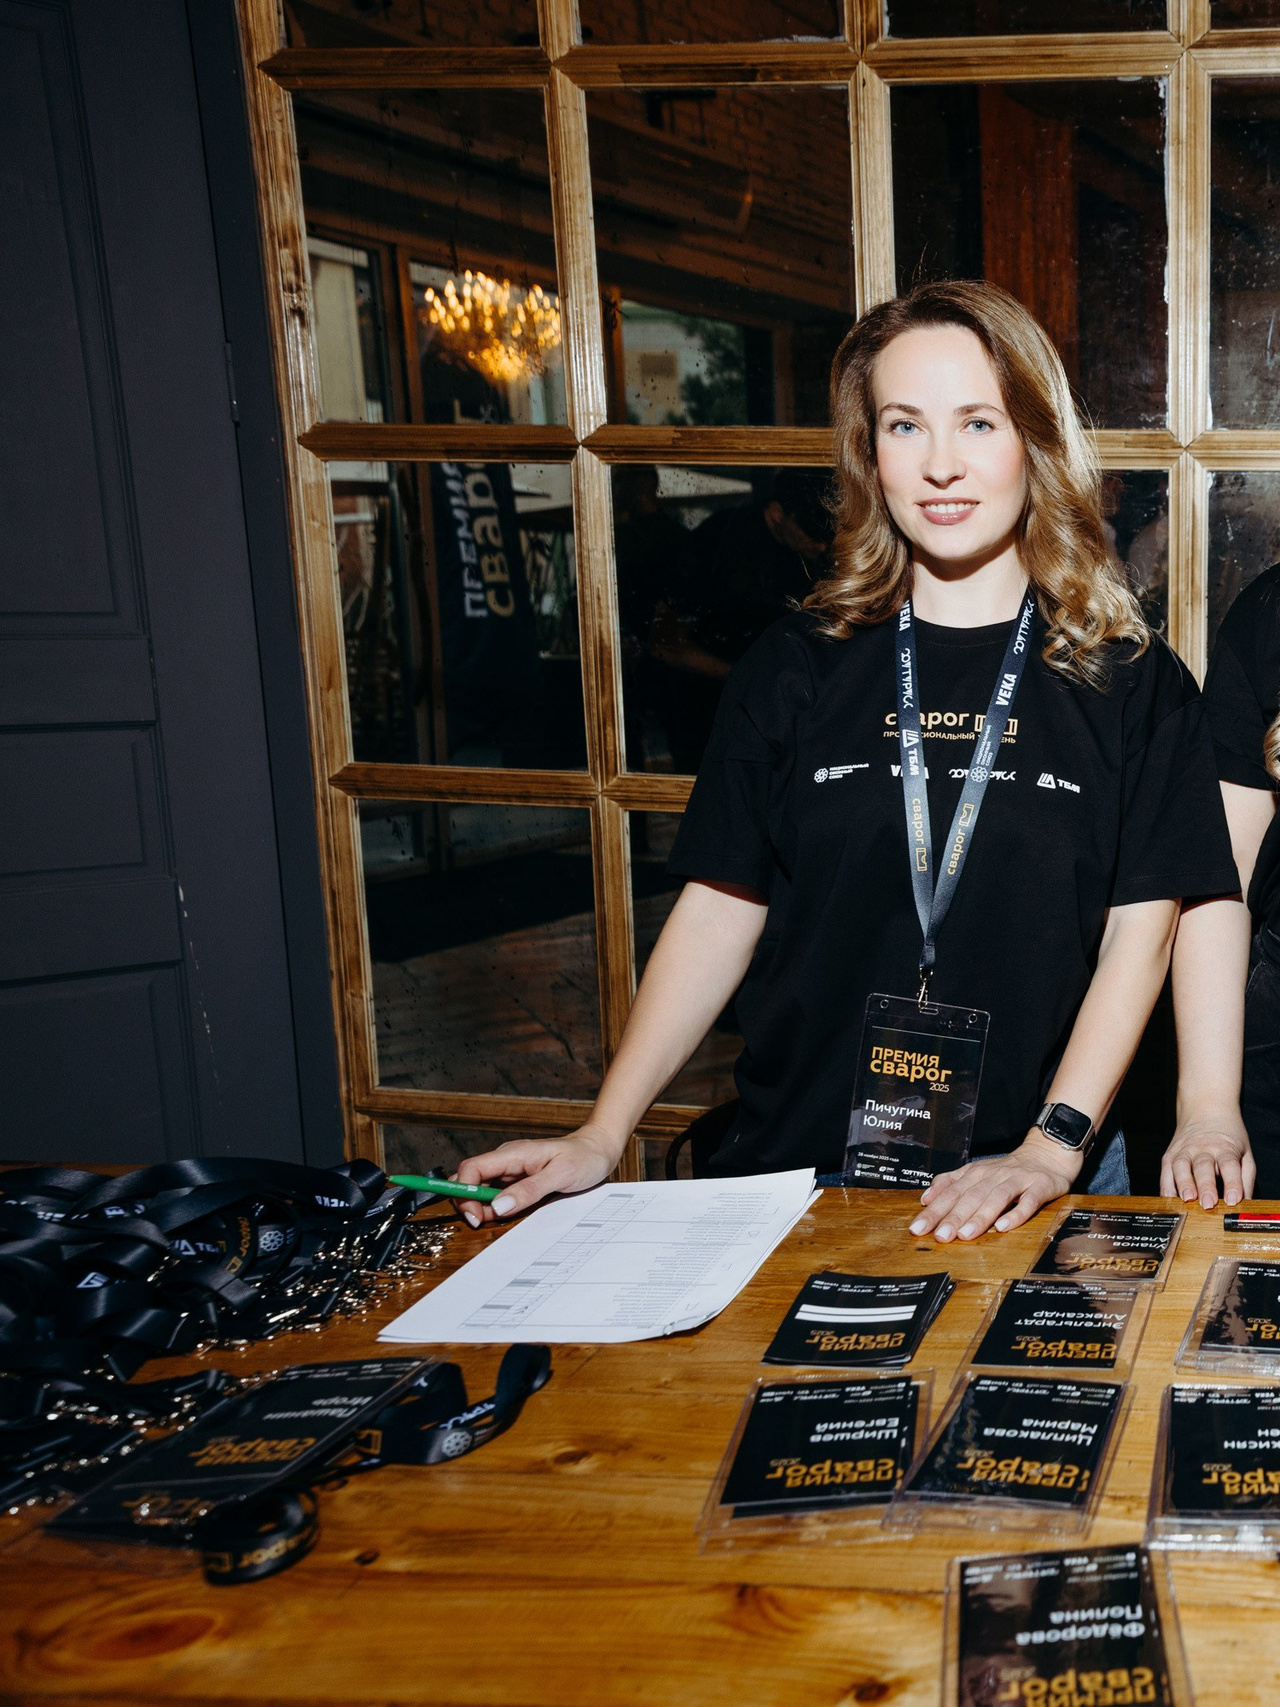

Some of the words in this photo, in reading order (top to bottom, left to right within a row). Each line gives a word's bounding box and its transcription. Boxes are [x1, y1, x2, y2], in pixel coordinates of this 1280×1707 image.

[899, 600, 911, 631] VEKA
[995, 673, 1018, 706] VEKA
[884, 711, 970, 730] сарог
[908, 748, 919, 776] ТБМ
[1057, 778, 1081, 794] ТБМ
[912, 798, 925, 845] сварог
[947, 829, 966, 875] сварог
[872, 1047, 940, 1068] ПРЕМИЯ
[870, 1060, 952, 1083] сварог
[929, 1083, 949, 1093] 2025
[865, 1100, 931, 1120] Пичугина
[863, 1115, 902, 1130] Юлия
[1087, 1233, 1169, 1243] Александр
[1113, 1241, 1167, 1249] Уланов
[1066, 1256, 1159, 1266] сварог
[1079, 1263, 1157, 1271] ПРЕМИЯ
[1014, 1318, 1124, 1329] Энгельгардт
[1033, 1311, 1127, 1321] Александр
[805, 1332, 906, 1344] сварог
[819, 1339, 903, 1351] ПРЕМИЯ
[1011, 1340, 1117, 1351] сварог
[1026, 1349, 1115, 1359] ПРЕМИЯ
[815, 1417, 899, 1433] Евгений
[1022, 1418, 1098, 1434] Марина
[810, 1428, 897, 1442] Ширшев
[983, 1427, 1093, 1446] Циплакова
[765, 1458, 895, 1479] сварог
[956, 1456, 1080, 1478] сварог
[784, 1468, 893, 1488] ПРЕМИЯ
[970, 1469, 1075, 1488] ПРЕМИЯ
[1050, 1604, 1143, 1624] Полина
[1016, 1622, 1145, 1645] Фёдорова
[999, 1668, 1154, 1701] сварог
